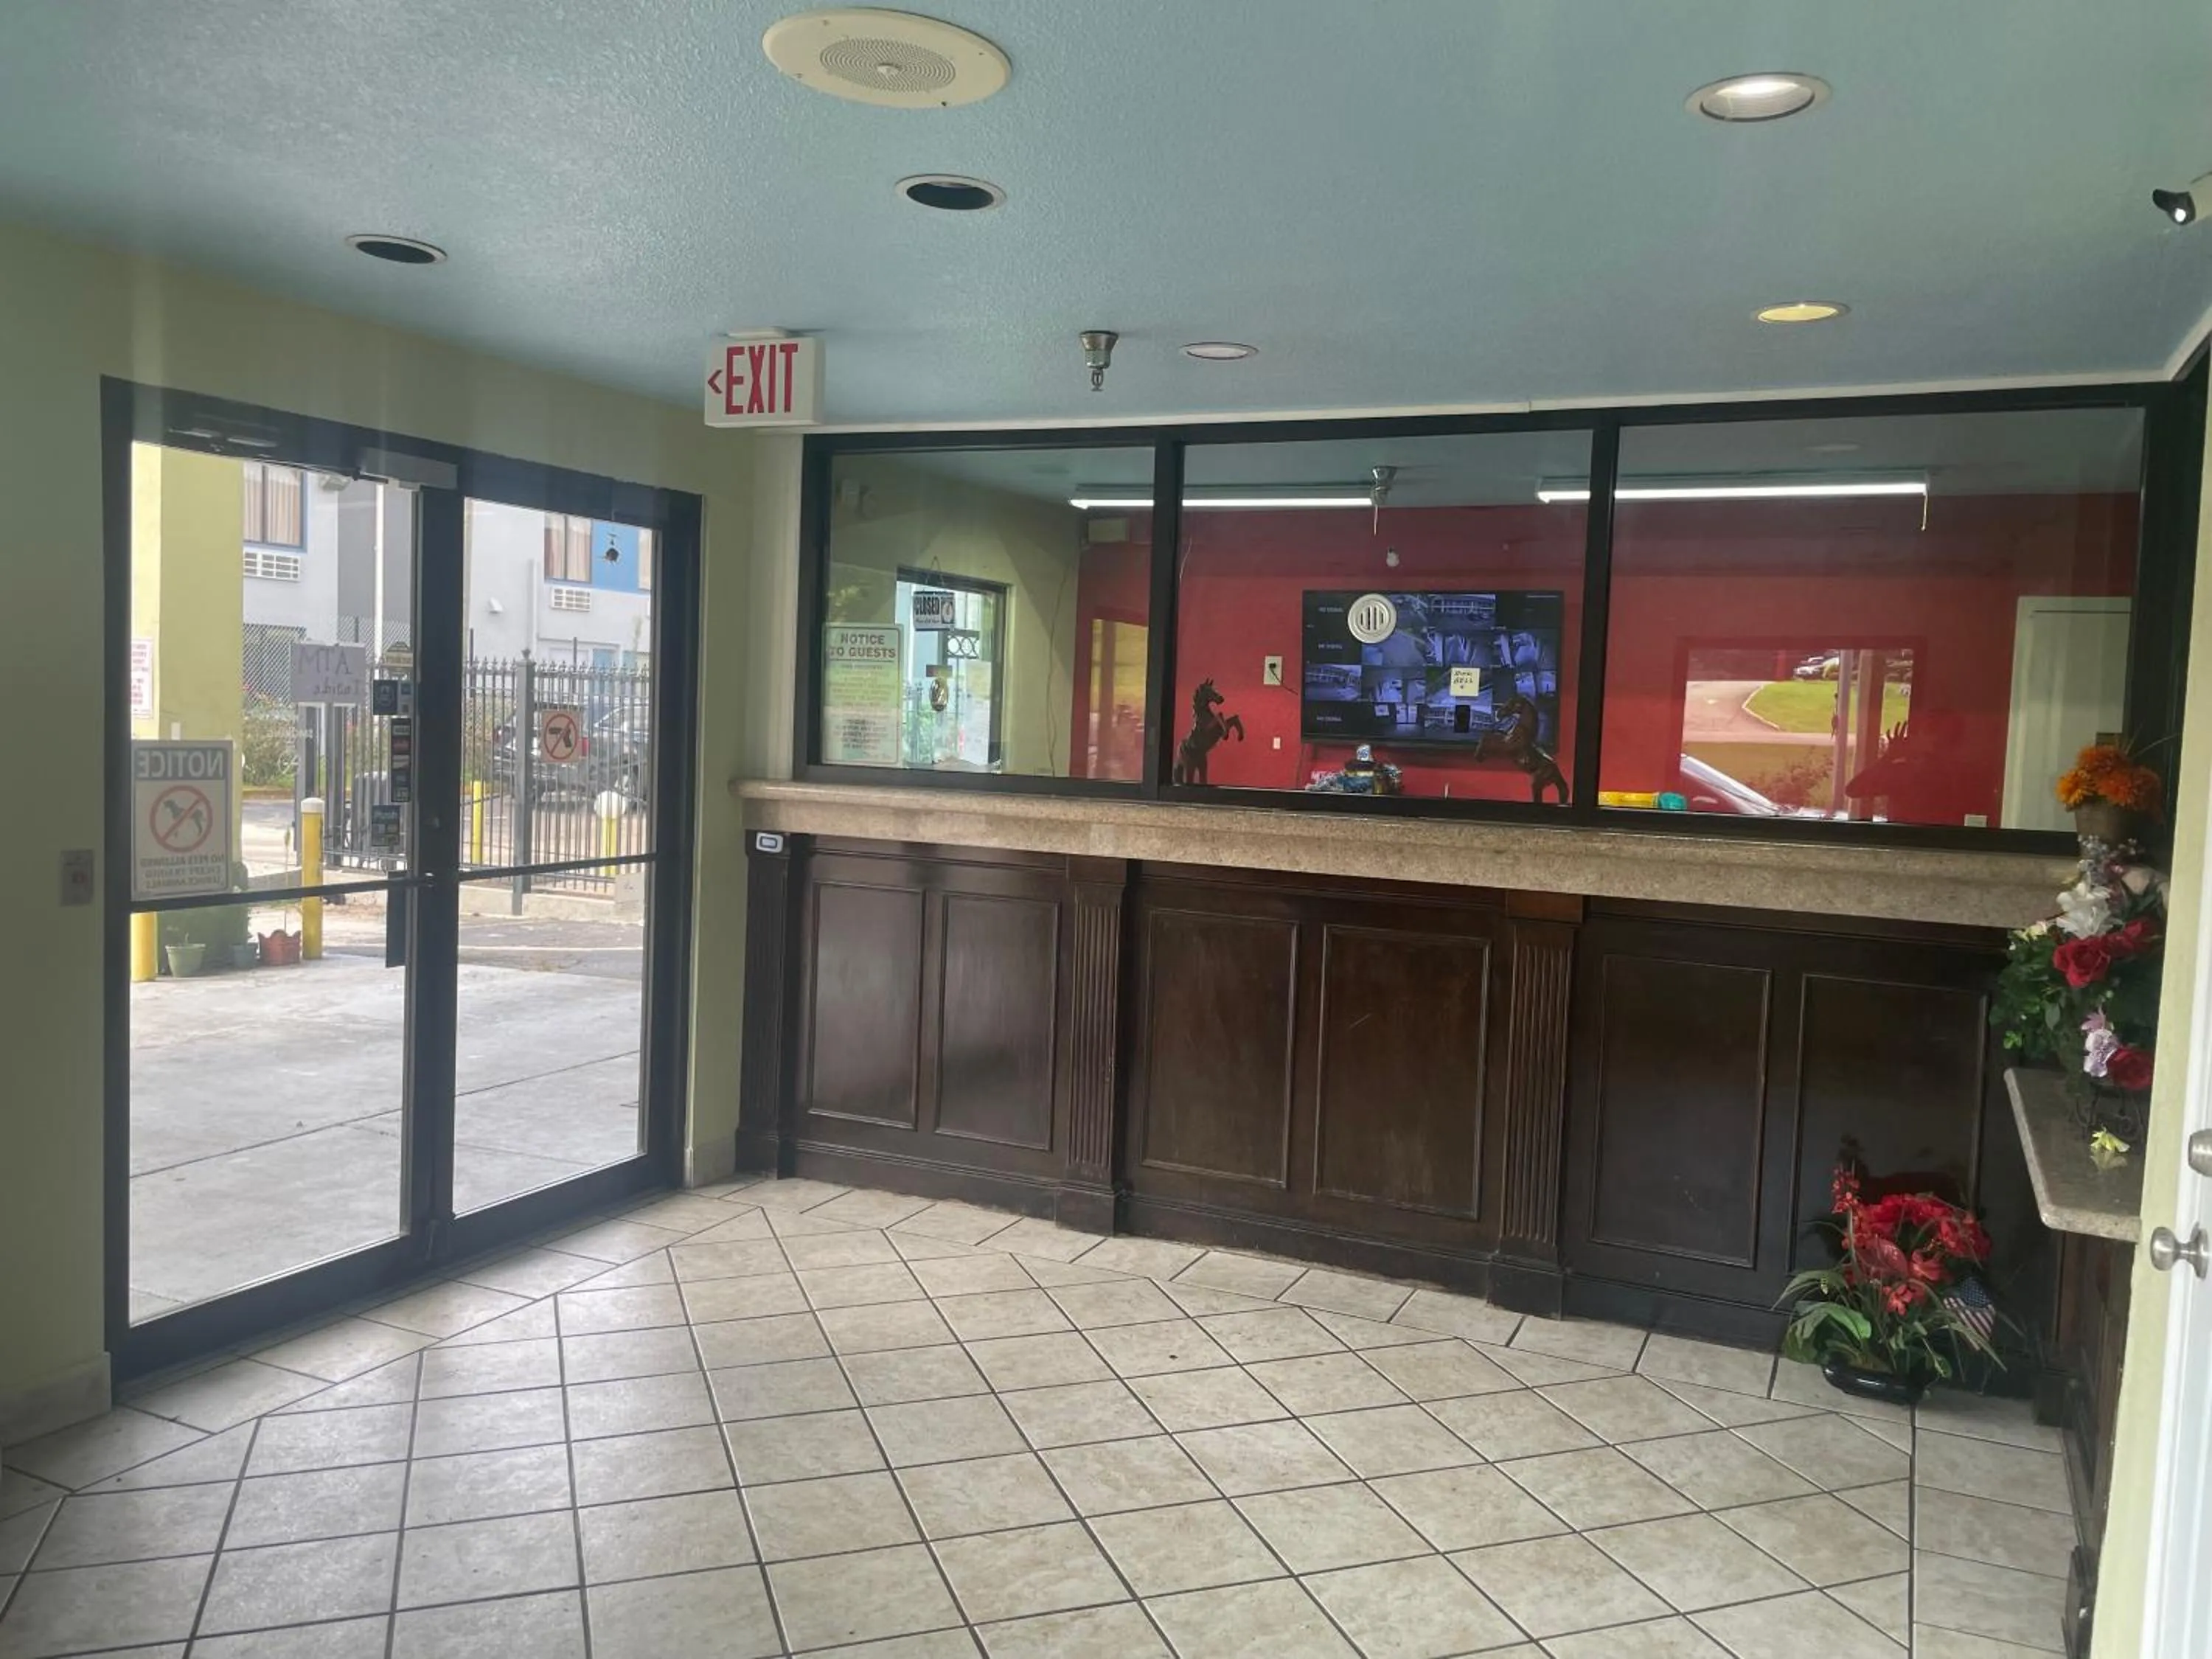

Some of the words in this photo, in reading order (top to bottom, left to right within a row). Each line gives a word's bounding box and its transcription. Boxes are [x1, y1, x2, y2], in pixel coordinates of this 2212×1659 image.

[725, 343, 799, 414] EXIT
[914, 596, 940, 616] CLOSED
[841, 633, 886, 645] NOTICE
[830, 646, 845, 657] TO
[849, 647, 897, 658] GUESTS
